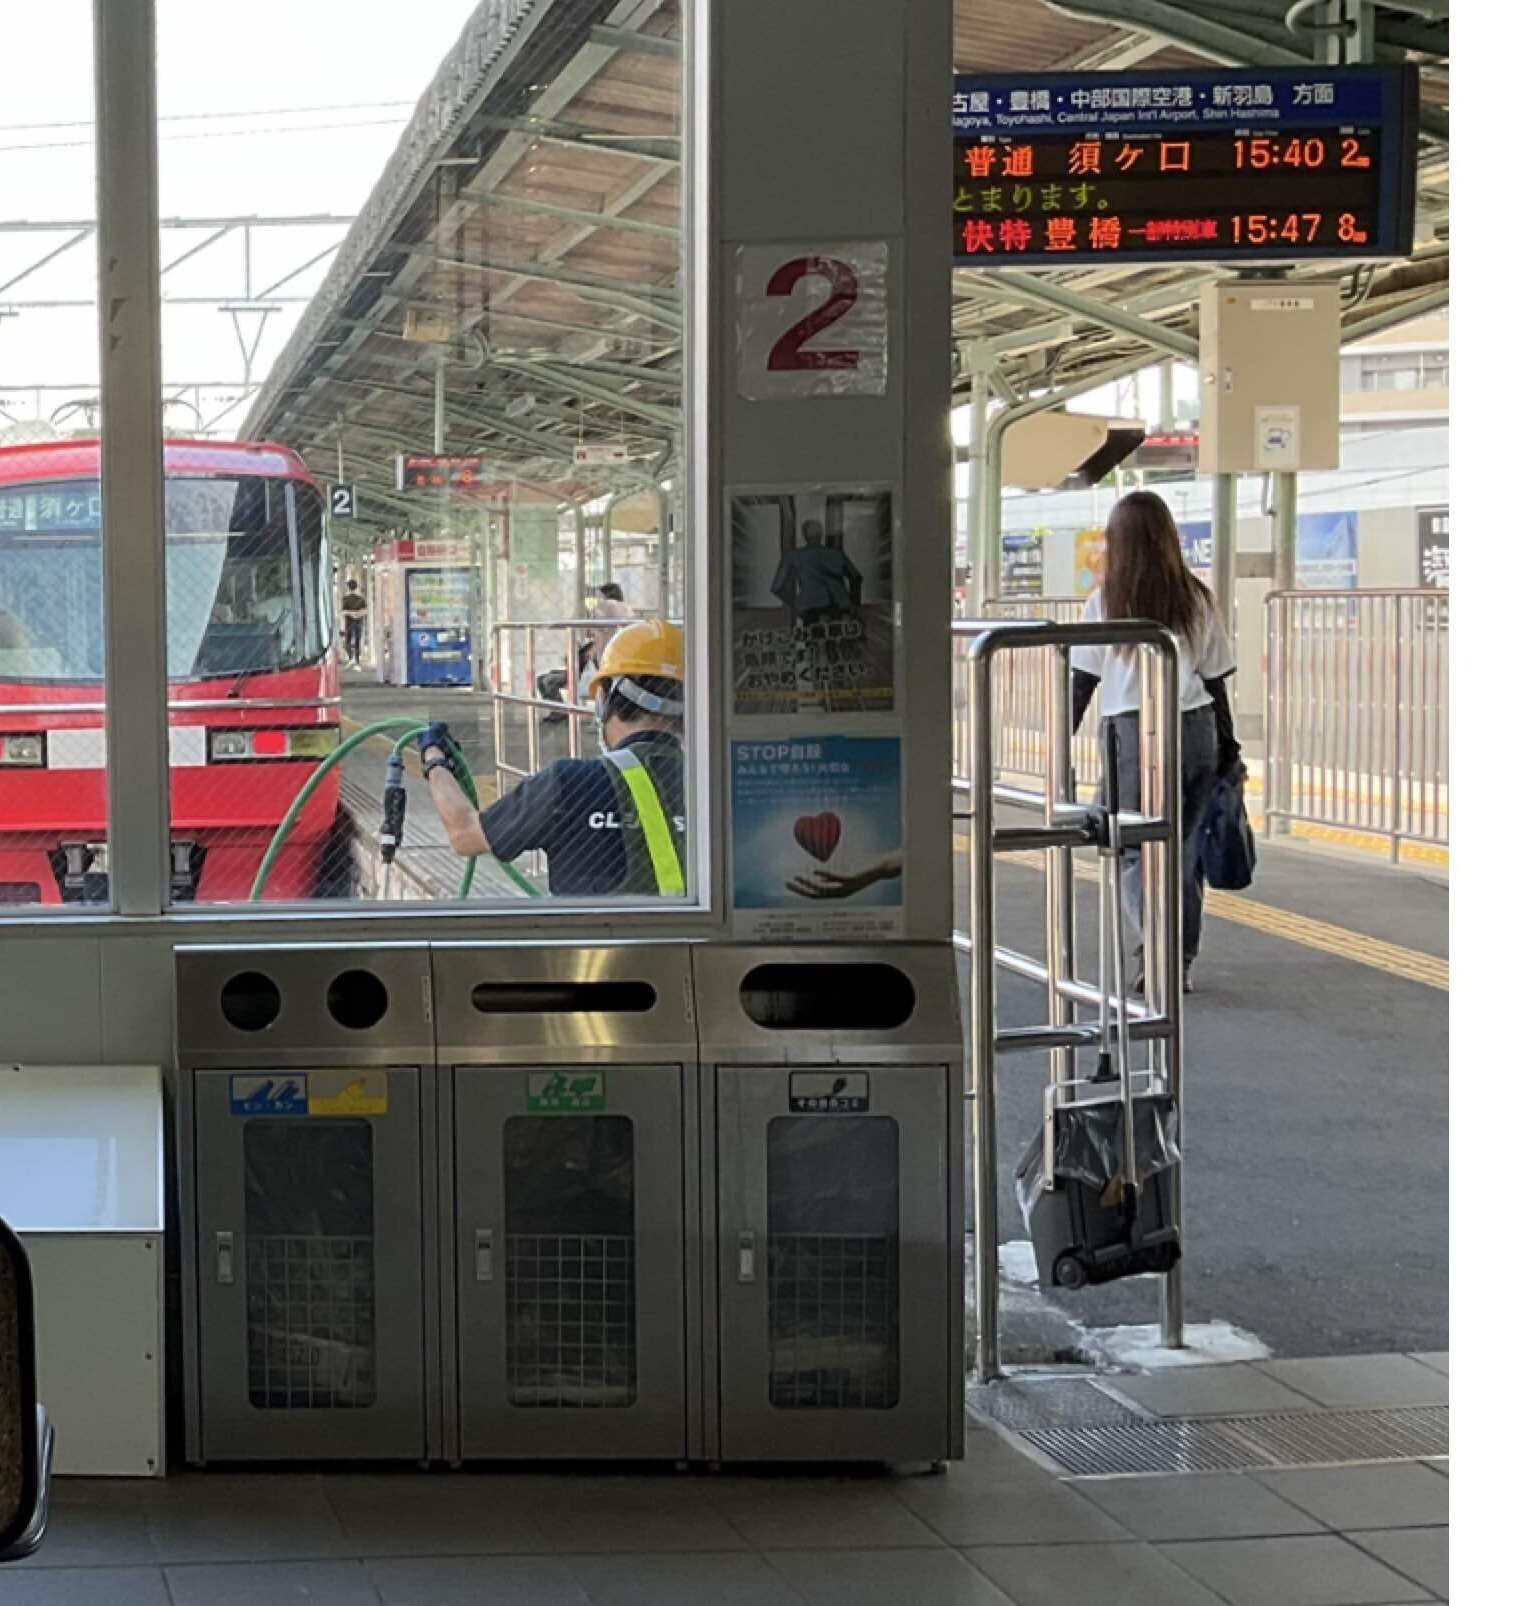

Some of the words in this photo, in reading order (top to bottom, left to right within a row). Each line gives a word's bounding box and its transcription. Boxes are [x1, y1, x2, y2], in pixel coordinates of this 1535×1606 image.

[1293, 83, 1334, 105] 方面
[953, 116, 992, 128] agoya,
[1057, 111, 1098, 123] Central
[1101, 111, 1136, 123] Japan
[964, 144, 1033, 177] 普通
[1233, 138, 1324, 169] 15:40
[953, 182, 1108, 213] とまります。
[963, 218, 1033, 253] 快特
[1044, 216, 1122, 251] 豊橋
[1231, 213, 1322, 245] 15:47
[767, 256, 860, 371] 2
[333, 489, 351, 513] 2
